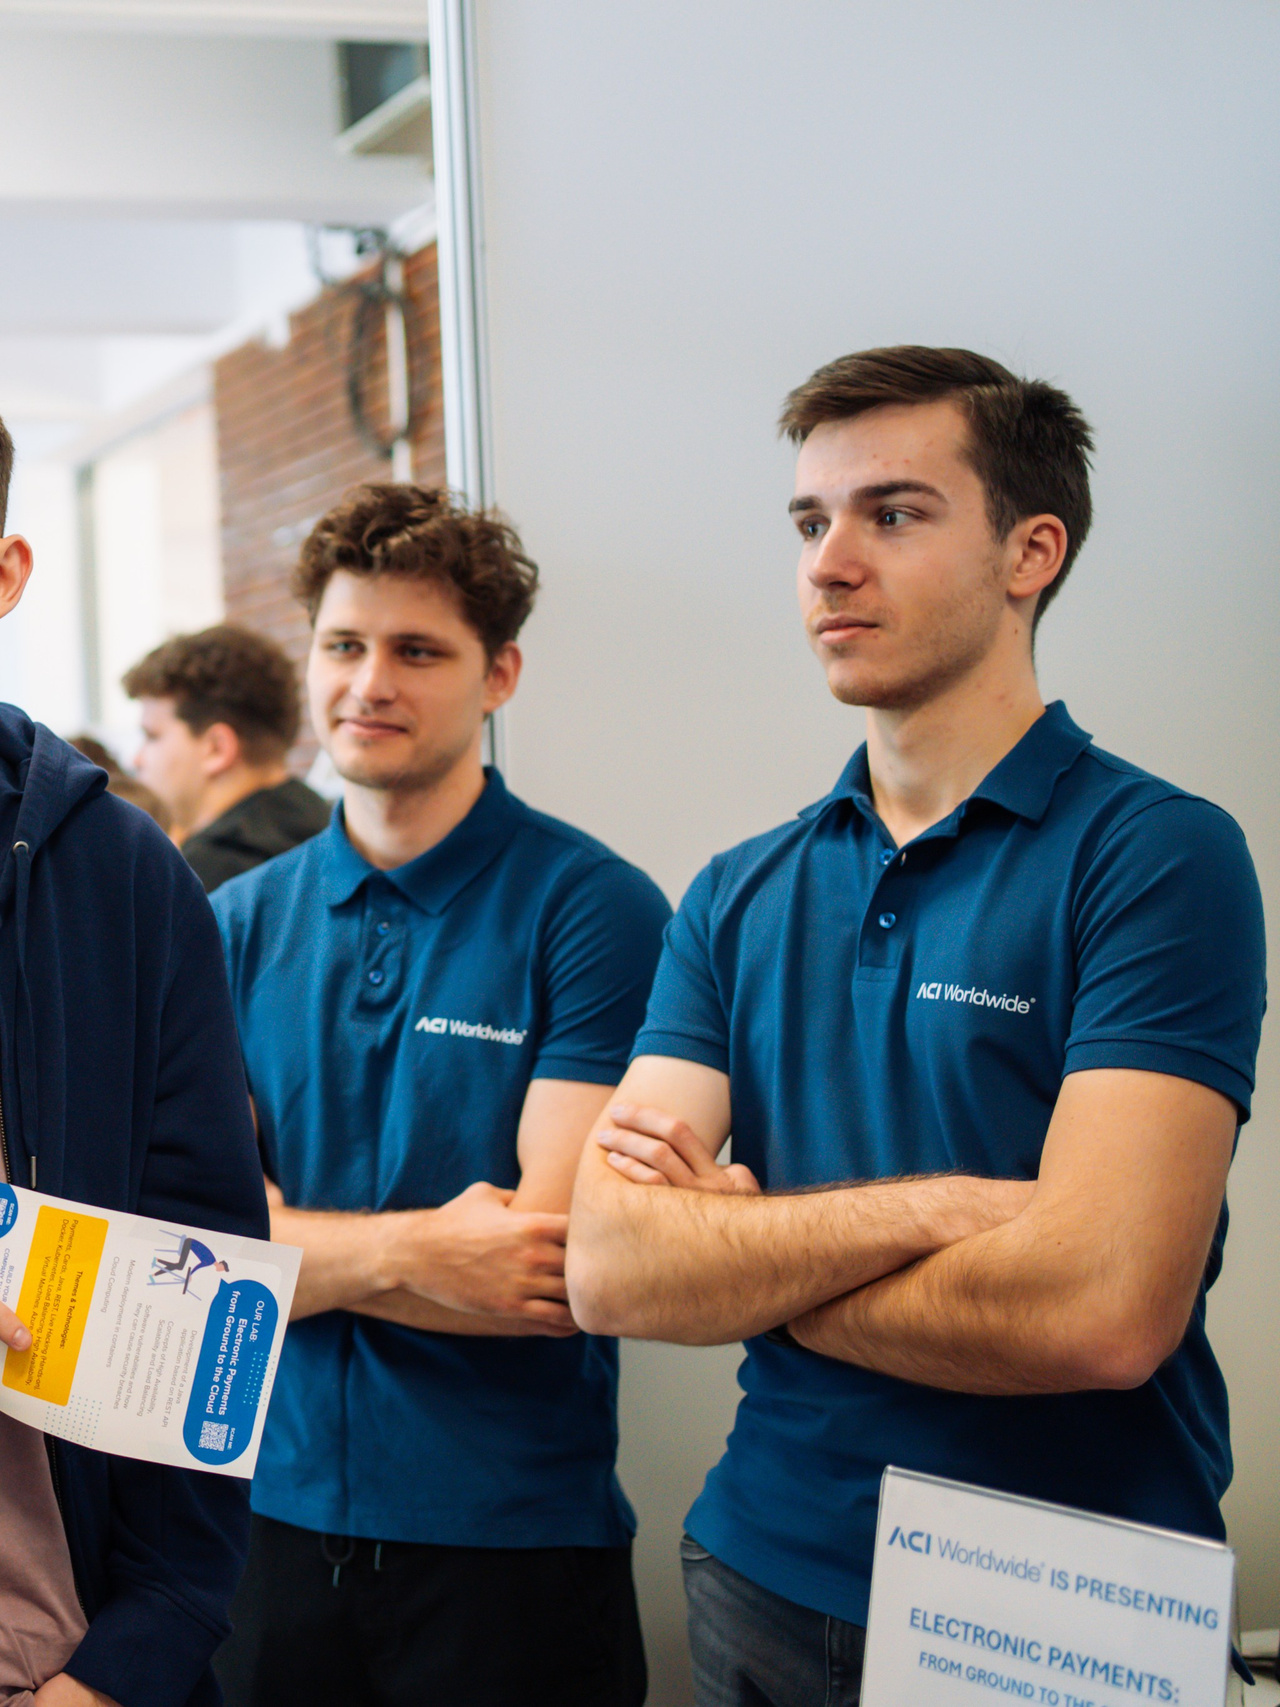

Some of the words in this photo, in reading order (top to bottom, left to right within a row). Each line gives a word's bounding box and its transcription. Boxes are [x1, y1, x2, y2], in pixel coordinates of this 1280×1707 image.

[916, 982, 942, 1000] ACI
[944, 983, 1031, 1014] Worldwide
[415, 1016, 448, 1035] ACI
[450, 1019, 524, 1045] Worldwide
[58, 1218, 69, 1243] Docker,
[65, 1219, 78, 1252] Payments,
[0, 1247, 10, 1279] COMPANY
[6, 1265, 14, 1283] BUILD
[42, 1255, 51, 1276] Virtual
[49, 1244, 63, 1283] Kubernetes,
[61, 1253, 70, 1275] Cards,
[110, 1256, 120, 1276] Cloud
[125, 1259, 135, 1285] Modern
[2, 1285, 10, 1303] YOUR
[46, 1284, 54, 1301] Load
[72, 1271, 83, 1297] Themes
[101, 1277, 115, 1313] Computing
[52, 1294, 61, 1312] REST,
[115, 1286, 129, 1325] deployment
[134, 1302, 142, 1318] they
[228, 1290, 240, 1313] from
[254, 1300, 264, 1321] OUR
[59, 1304, 75, 1349] Technologies:
[140, 1304, 152, 1334] Software
[33, 1336, 41, 1352] High
[42, 1328, 53, 1355] Hacking
[127, 1331, 135, 1351] cause
[152, 1319, 165, 1352] Scalability
[161, 1320, 174, 1352] Concepts
[220, 1315, 235, 1353] Ground
[230, 1318, 247, 1367] Electronic
[249, 1322, 260, 1343] LAB:
[106, 1333, 119, 1368] containers
[130, 1335, 145, 1380] vulnerabilities
[161, 1353, 166, 1361] of
[175, 1328, 188, 1364] application
[182, 1329, 197, 1374] Development
[120, 1353, 131, 1378] security
[155, 1361, 165, 1378] High
[217, 1354, 226, 1365] to
[127, 1380, 135, 1394] and
[146, 1367, 154, 1384] Load
[171, 1365, 180, 1385] based
[213, 1366, 224, 1383] the
[114, 1379, 125, 1410] breaches
[124, 1394, 132, 1409] how
[137, 1384, 150, 1417] Balancing
[147, 1378, 161, 1415] Availability,
[169, 1386, 174, 1396] on
[176, 1389, 184, 1404] Java
[206, 1384, 220, 1414] Cloud
[217, 1368, 236, 1416] Payments
[165, 1397, 173, 1414] REST
[887, 1526, 932, 1556] ACI
[938, 1536, 1042, 1584] Worldwide
[1050, 1568, 1069, 1591] IS
[1075, 1574, 1220, 1631] PRESENTING
[910, 1607, 1041, 1663] ELECTRONIC
[1049, 1647, 1180, 1704] PAYMENTS:
[920, 1651, 962, 1677] FROM
[966, 1665, 1035, 1699] GROUND
[1039, 1686, 1059, 1706] TO
